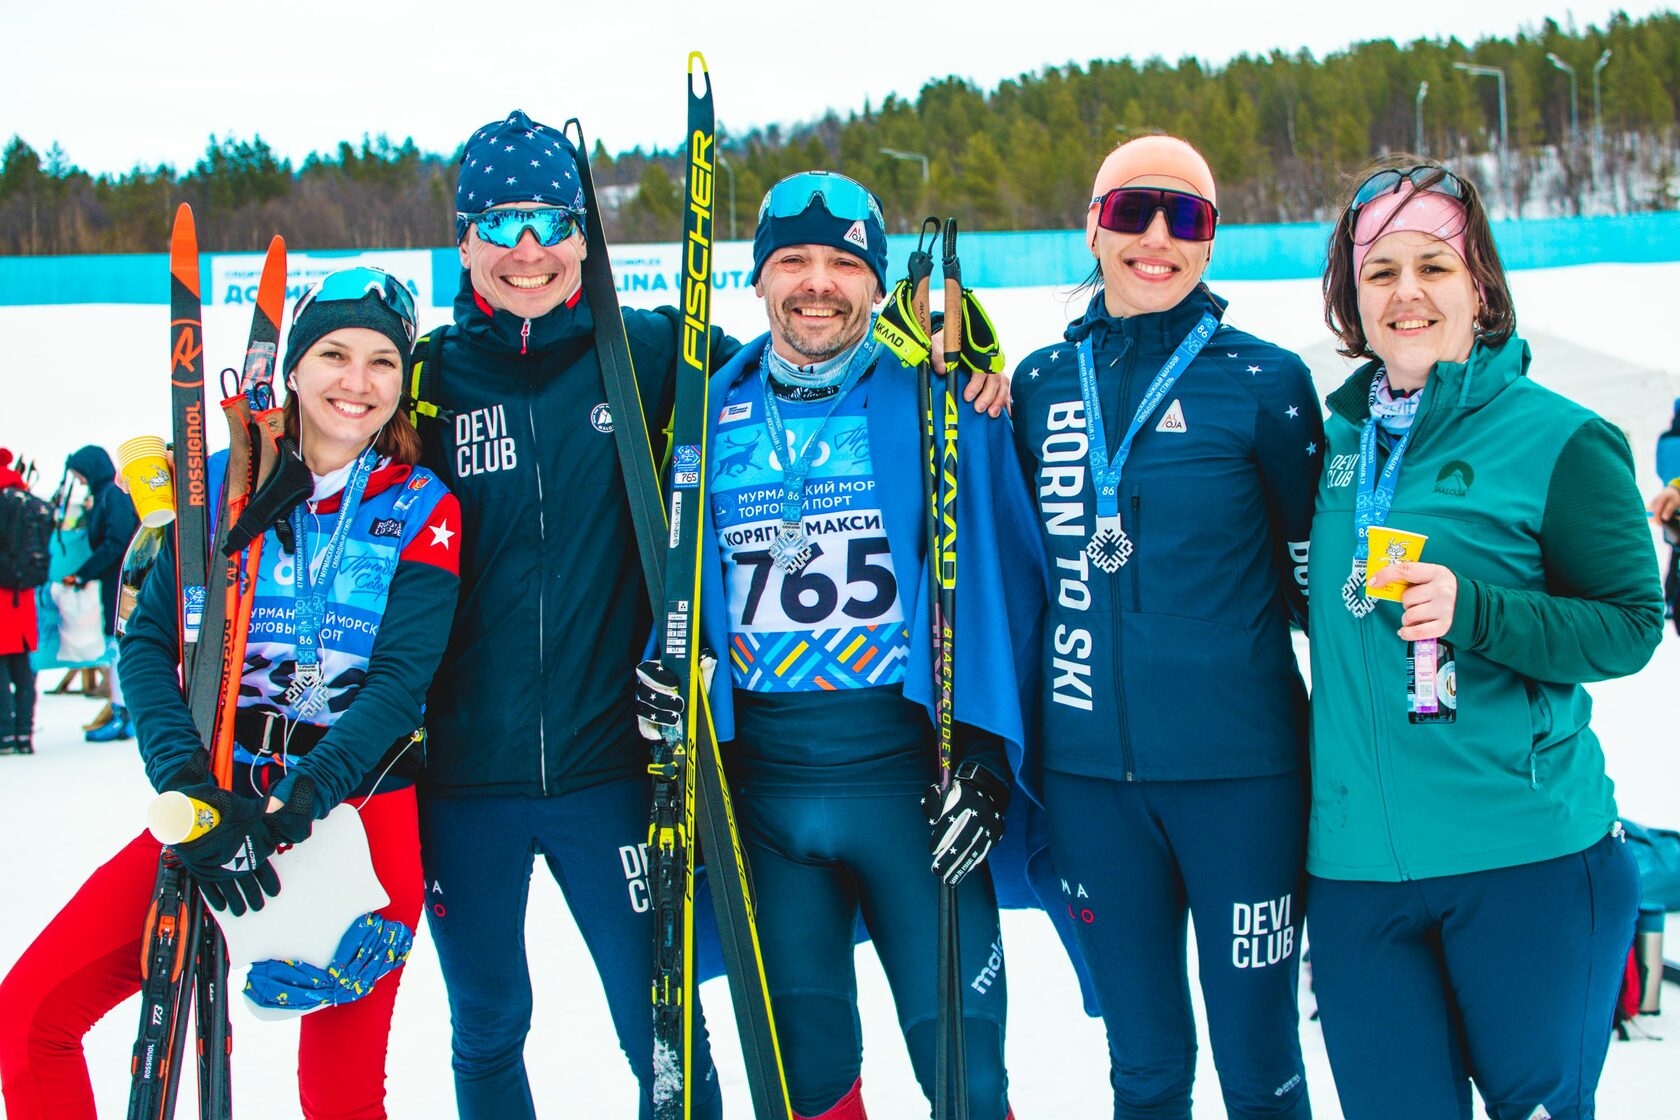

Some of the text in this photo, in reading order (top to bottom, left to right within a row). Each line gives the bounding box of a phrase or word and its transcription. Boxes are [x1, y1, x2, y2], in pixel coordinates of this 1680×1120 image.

[683, 129, 713, 371] FISCHER
[864, 342, 873, 353] 86
[1197, 325, 1209, 338] 86
[456, 404, 507, 446] DEVI
[186, 400, 205, 506] ROSSIGNOL
[457, 437, 517, 478] CLUB
[1040, 400, 1089, 537] BORN
[1330, 454, 1360, 470] DEVI
[682, 473, 697, 482] 765
[738, 481, 834, 504] МУРМАКИЙ
[1102, 486, 1115, 496] 86
[1327, 470, 1354, 488] CLUB
[738, 496, 852, 518] ТОРГОЙ ПОРТ
[787, 491, 800, 501] 86
[724, 515, 882, 547] КОРЯГИ МАКСИ
[731, 537, 898, 626] 765
[1056, 550, 1092, 611] TO
[299, 635, 312, 645] 86
[1052, 623, 1093, 711] SKI
[686, 737, 696, 903] FISCHER
[1233, 894, 1291, 937] DEVI
[1232, 925, 1293, 969] CLUB
[144, 1043, 155, 1079] ROSSIGNOL
